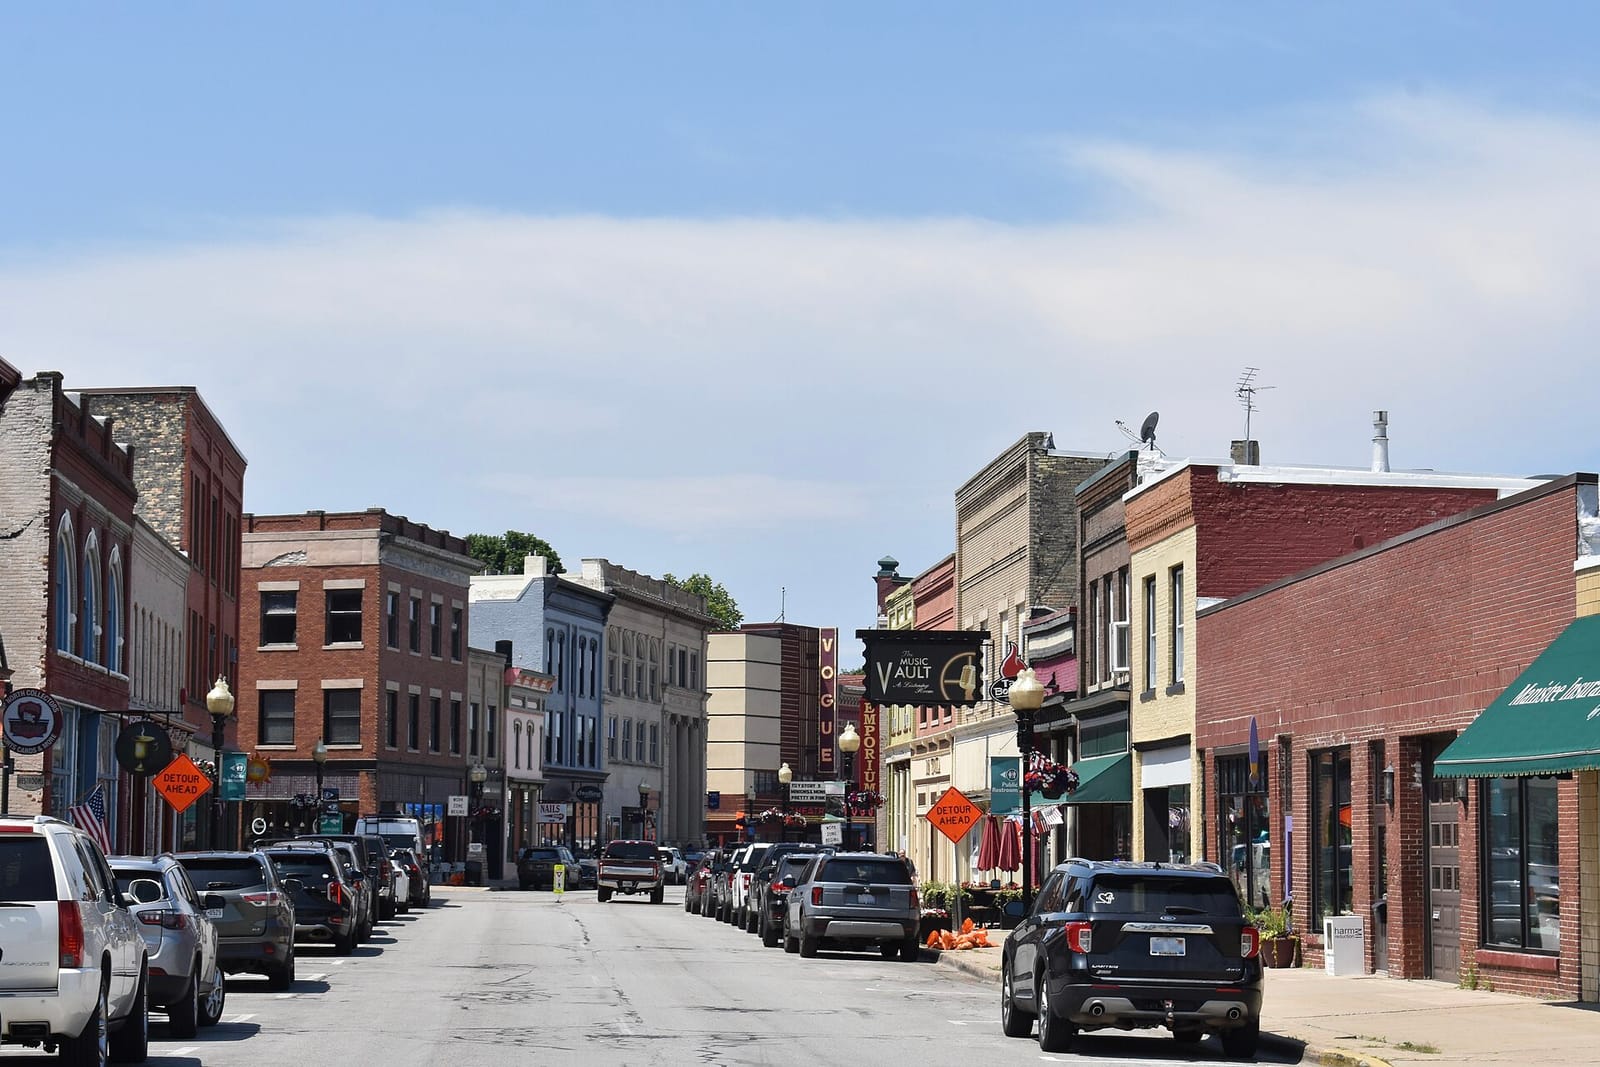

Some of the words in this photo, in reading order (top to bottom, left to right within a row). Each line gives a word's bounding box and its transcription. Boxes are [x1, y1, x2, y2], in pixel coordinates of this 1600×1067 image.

[899, 657, 929, 666] MUSIC
[876, 661, 932, 695] VAULT
[902, 681, 930, 689] Listening
[1001, 679, 1015, 688] Ta
[994, 687, 1009, 696] Bo
[1508, 680, 1568, 706] Manistee
[6, 690, 26, 705] NORTH
[26, 689, 60, 713] COLLECTORS
[820, 637, 834, 763] VOGUE
[17, 745, 37, 754] CARDS
[42, 734, 58, 748] MORE
[863, 702, 877, 792] EMPORIUM
[163, 773, 200, 784] DETOUR
[165, 784, 198, 794] AHEAD
[540, 804, 561, 813] NAILS
[936, 805, 971, 815] DETOUR
[940, 815, 970, 825] AHEAD
[1334, 927, 1355, 935] harm
